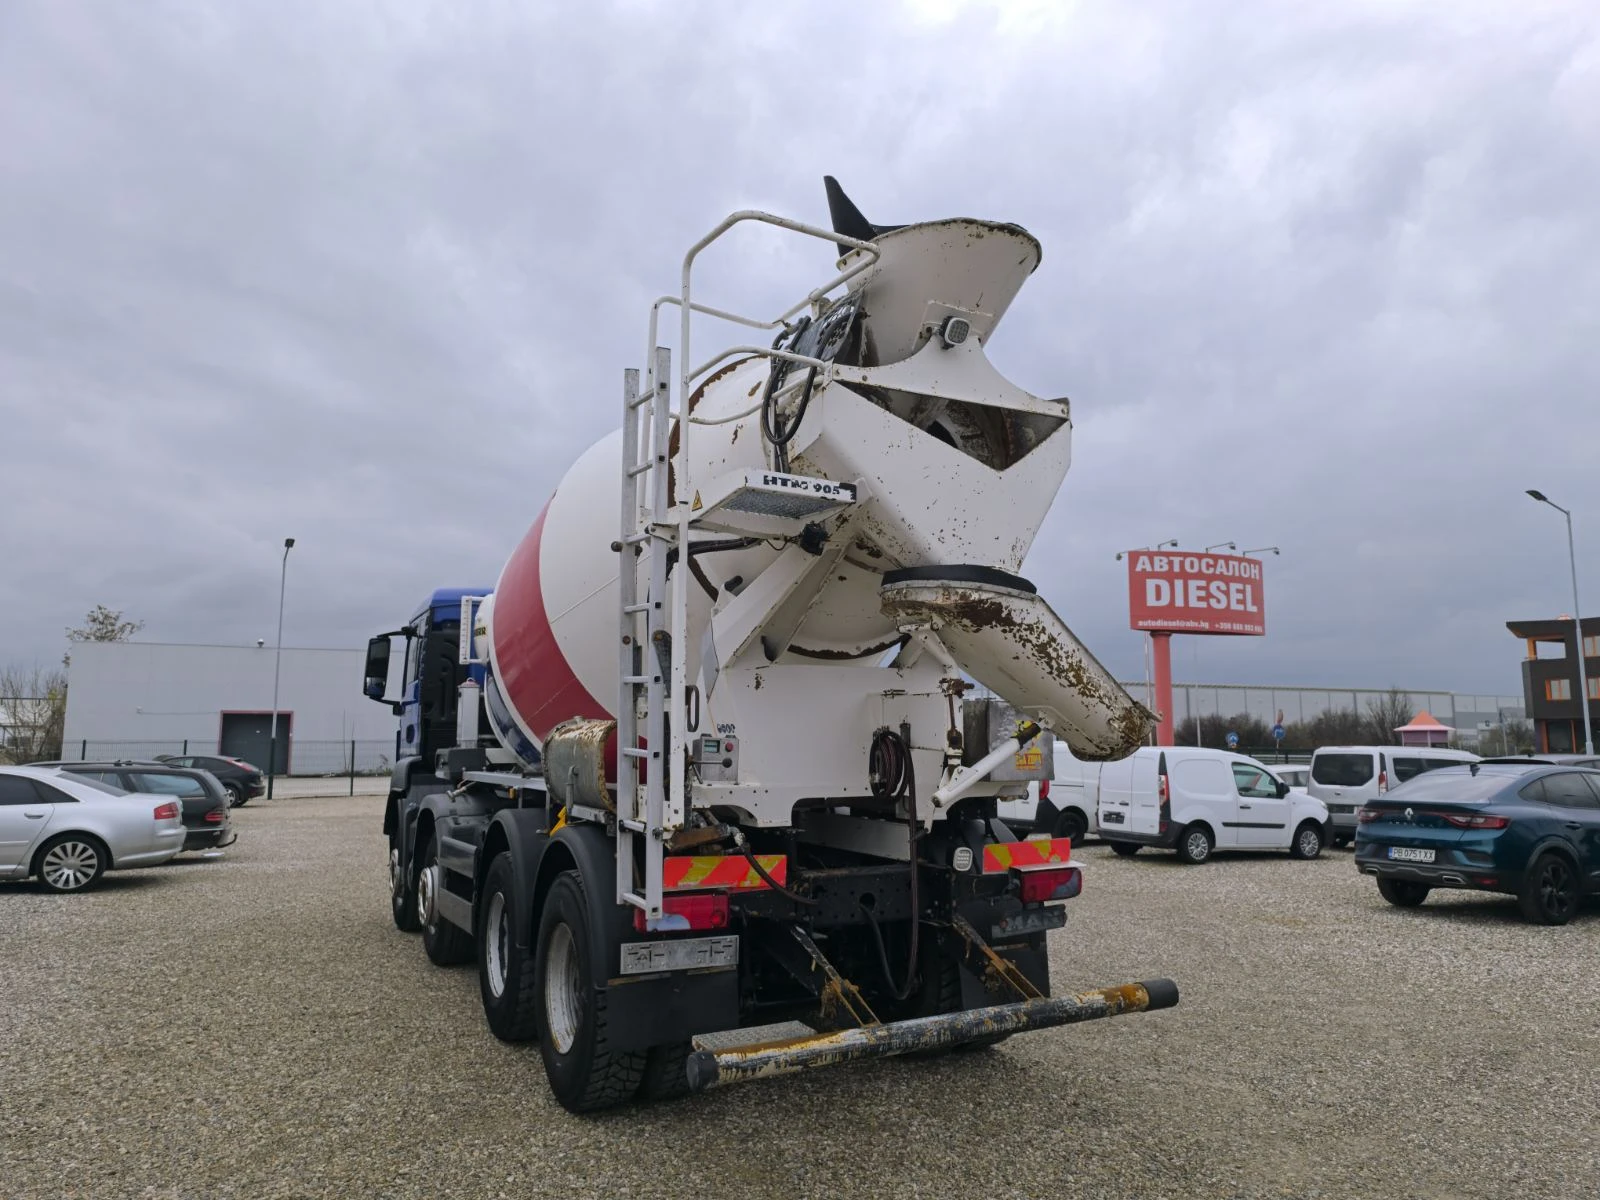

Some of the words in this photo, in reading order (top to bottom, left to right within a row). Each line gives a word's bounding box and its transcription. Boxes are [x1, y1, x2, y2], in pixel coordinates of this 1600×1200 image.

[813, 483, 840, 495] 905
[1135, 555, 1260, 580] АВТОСАЛОН
[1145, 578, 1258, 613] DIESEL
